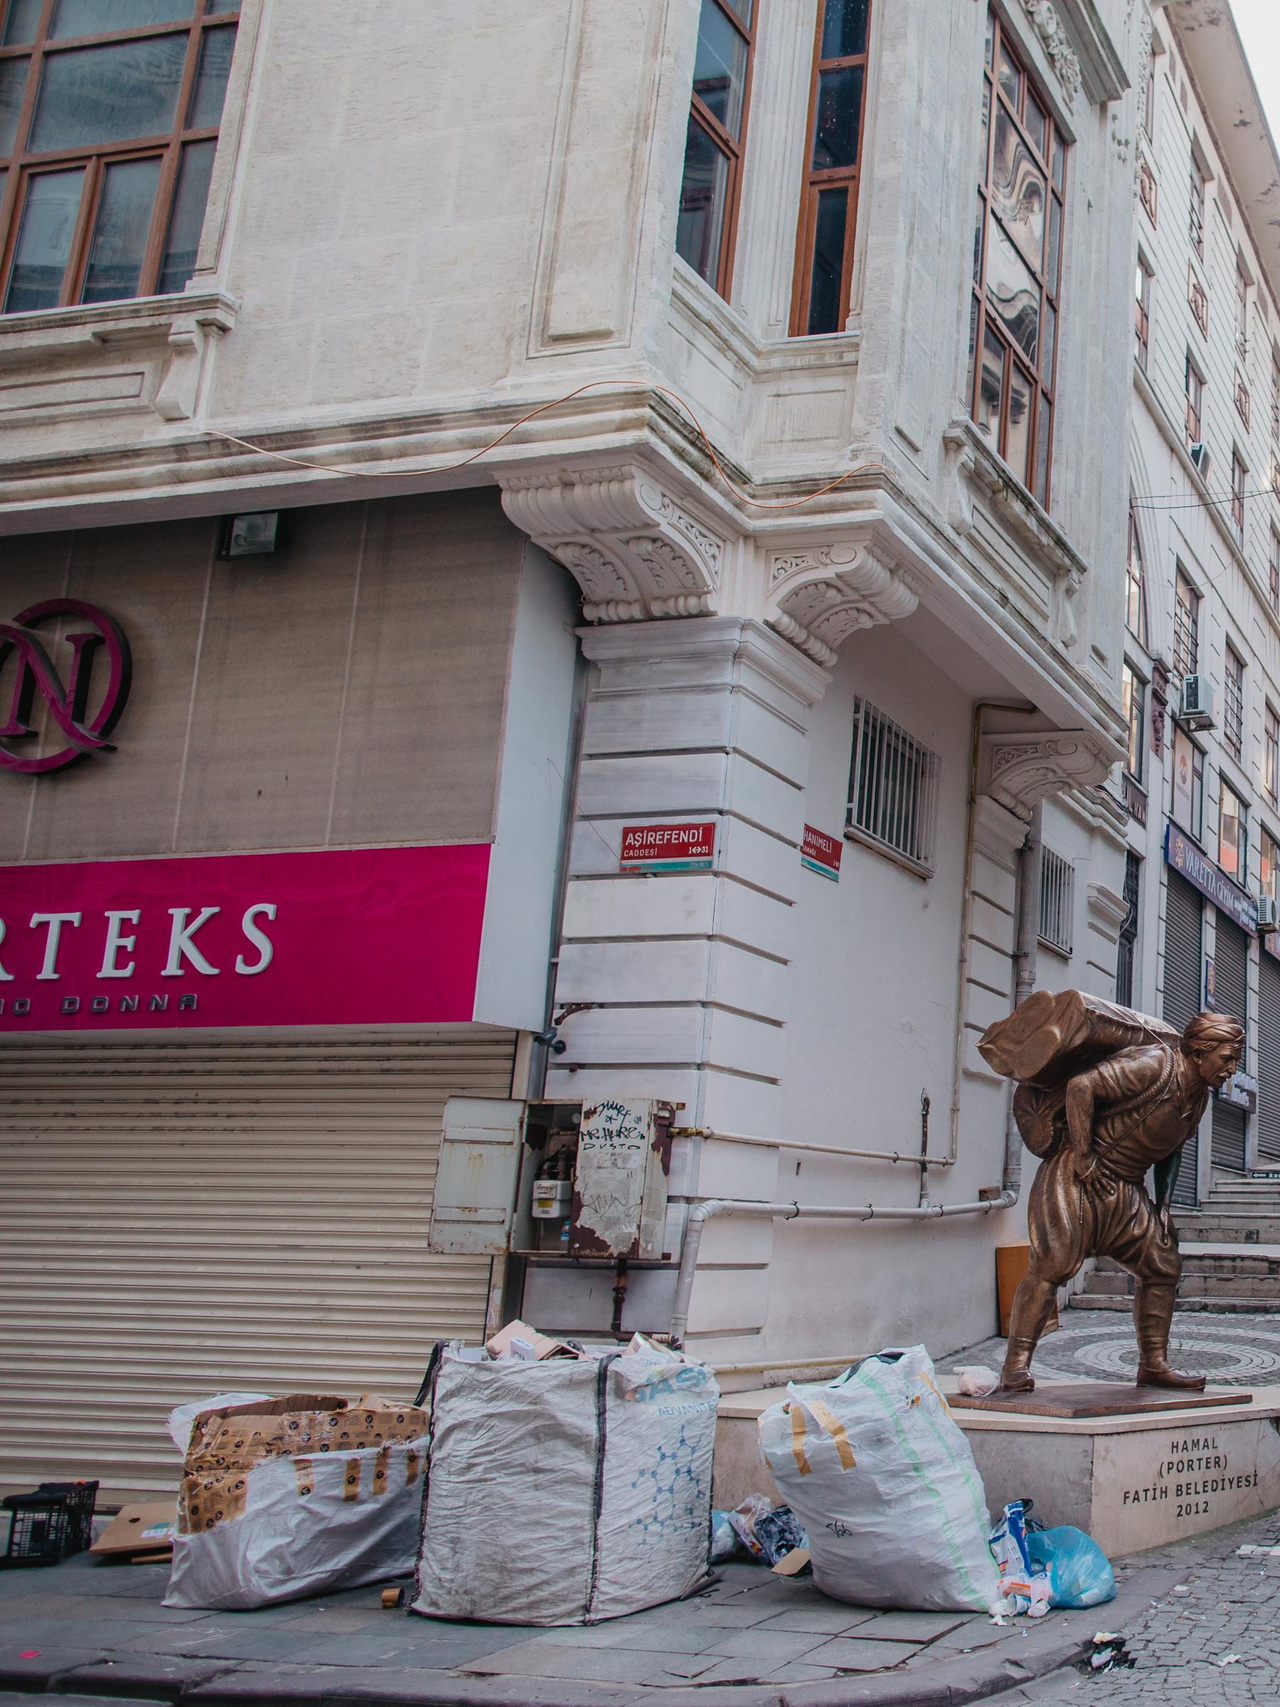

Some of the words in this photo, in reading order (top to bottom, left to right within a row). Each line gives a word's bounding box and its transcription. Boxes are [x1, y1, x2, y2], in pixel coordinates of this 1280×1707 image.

[625, 827, 703, 848] AŞİREFENDİ
[623, 848, 658, 858] CADDESİ
[1185, 846, 1217, 897] VARETTA
[61, 994, 198, 1014] DONNA
[1171, 1437, 1218, 1454] HAMAL
[1160, 1455, 1228, 1478] (PORTER)
[1123, 1483, 1168, 1504] FATİH
[1175, 1469, 1258, 1498] BELEDİYESİ
[1176, 1500, 1210, 1517] 2012
